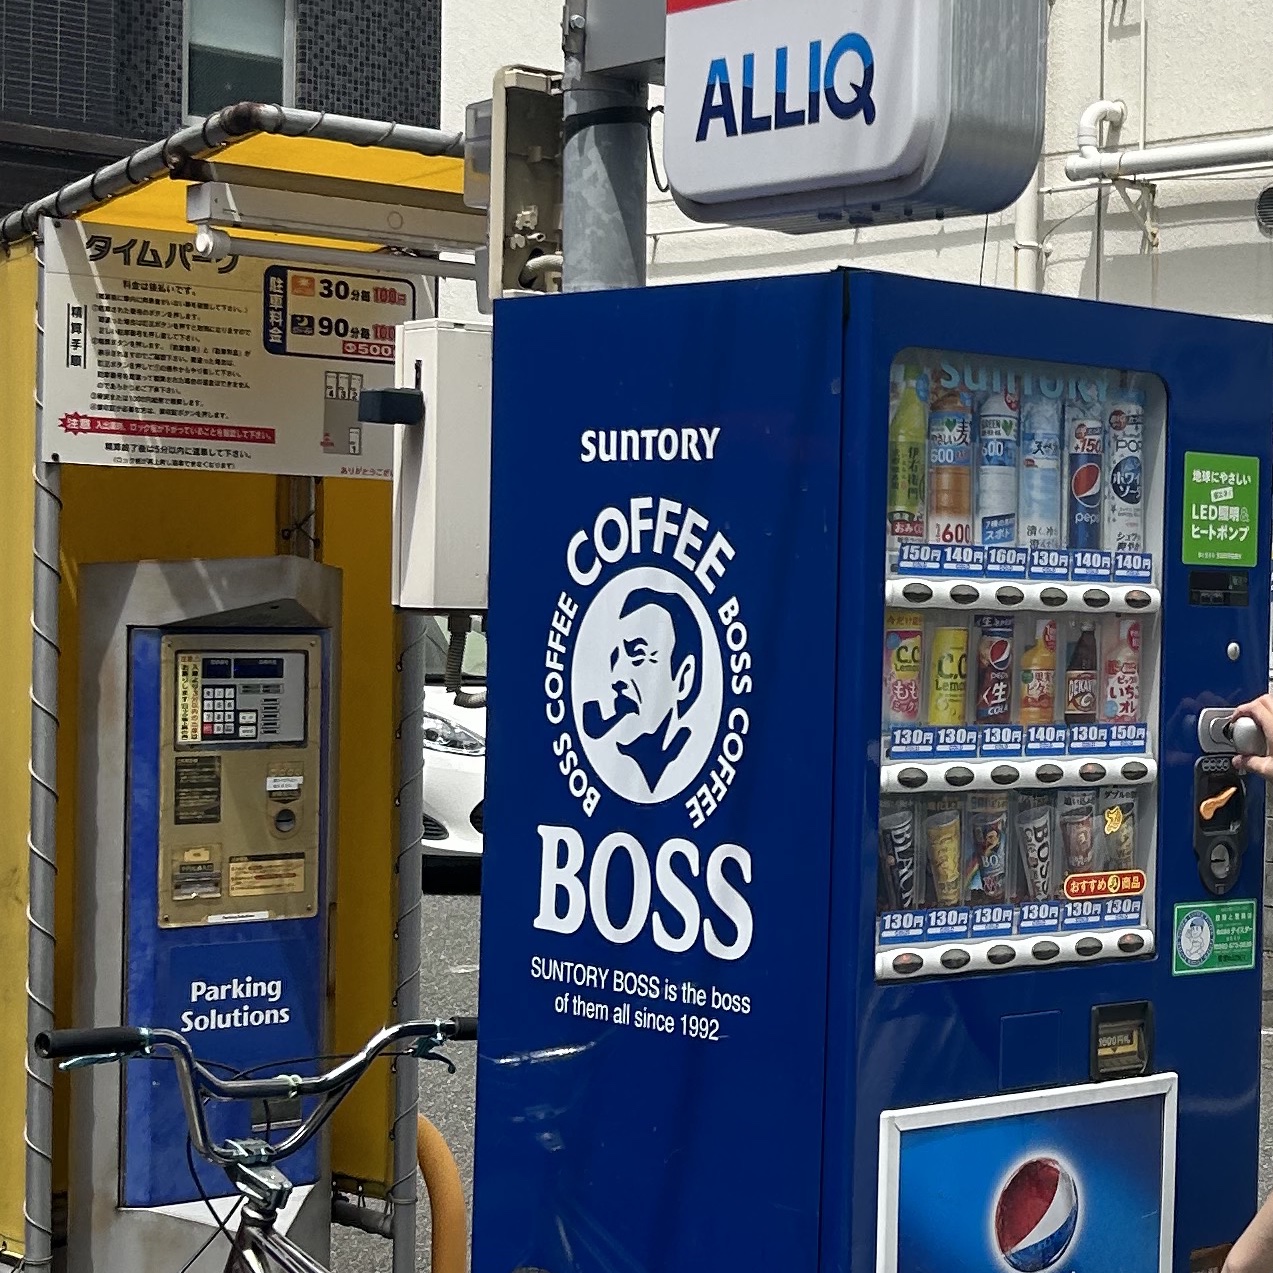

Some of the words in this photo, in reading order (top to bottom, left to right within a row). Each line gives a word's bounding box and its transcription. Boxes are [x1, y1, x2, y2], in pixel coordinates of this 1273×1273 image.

[695, 32, 876, 143] ALLIQ
[1192, 469, 1251, 486] 地球にやさしい
[567, 496, 736, 595] COFFEE
[901, 545, 942, 561] 150円
[944, 547, 984, 563] 140円
[989, 548, 1026, 564] 160円
[1032, 551, 1068, 566] 130円
[1074, 553, 1110, 568] 140円
[1116, 554, 1151, 570] 140円
[1191, 524, 1250, 542] ヒートポンプ
[544, 591, 579, 724] COFFEE
[718, 596, 753, 695] BOSS
[893, 729, 934, 744] 130円
[938, 728, 977, 744] 130円
[984, 728, 1021, 743] 130円
[1028, 727, 1065, 742] 140円
[1072, 726, 1107, 741] 130円
[1110, 725, 1145, 740] 150円
[553, 732, 601, 817] BOSS
[685, 707, 750, 829] COFFEE
[533, 824, 754, 961] BOSS
[883, 913, 924, 930] 130円
[929, 911, 968, 926] 130円
[974, 908, 1012, 923] 130円
[1021, 904, 1058, 919] 130円
[1065, 901, 1102, 916] 130円
[1105, 899, 1141, 914] 130円
[191, 976, 282, 1003] Parking
[531, 956, 610, 990] SUNTORY
[613, 970, 660, 999] BOSS
[664, 978, 677, 1002] is
[682, 982, 707, 1007] the
[711, 986, 751, 1014] boss
[180, 1004, 290, 1033] Solutions
[555, 992, 570, 1013] of
[573, 995, 609, 1022] them
[613, 1003, 630, 1026] all
[634, 1007, 675, 1034] since
[681, 1015, 720, 1041] 1992
